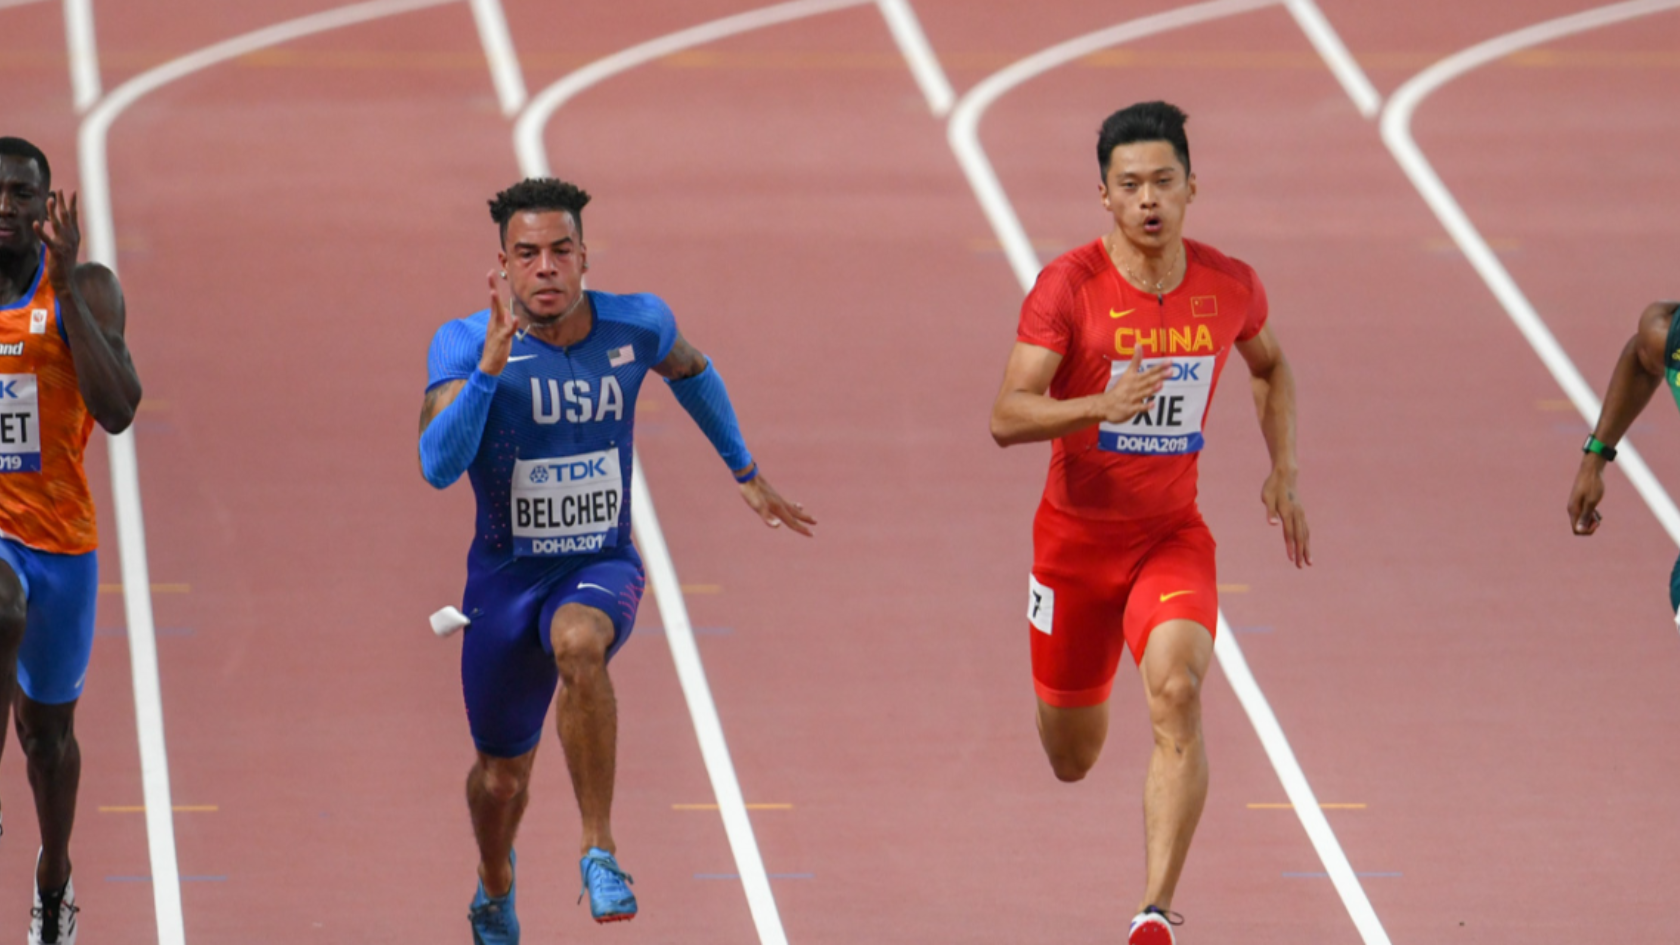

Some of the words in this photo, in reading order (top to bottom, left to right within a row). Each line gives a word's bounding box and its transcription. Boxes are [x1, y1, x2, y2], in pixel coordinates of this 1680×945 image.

[1115, 325, 1213, 355] CHINA
[1144, 362, 1201, 381] DK
[530, 375, 624, 424] USA
[549, 457, 607, 482] TDK
[516, 489, 617, 528] BELCHER
[532, 533, 606, 554] DOHA201
